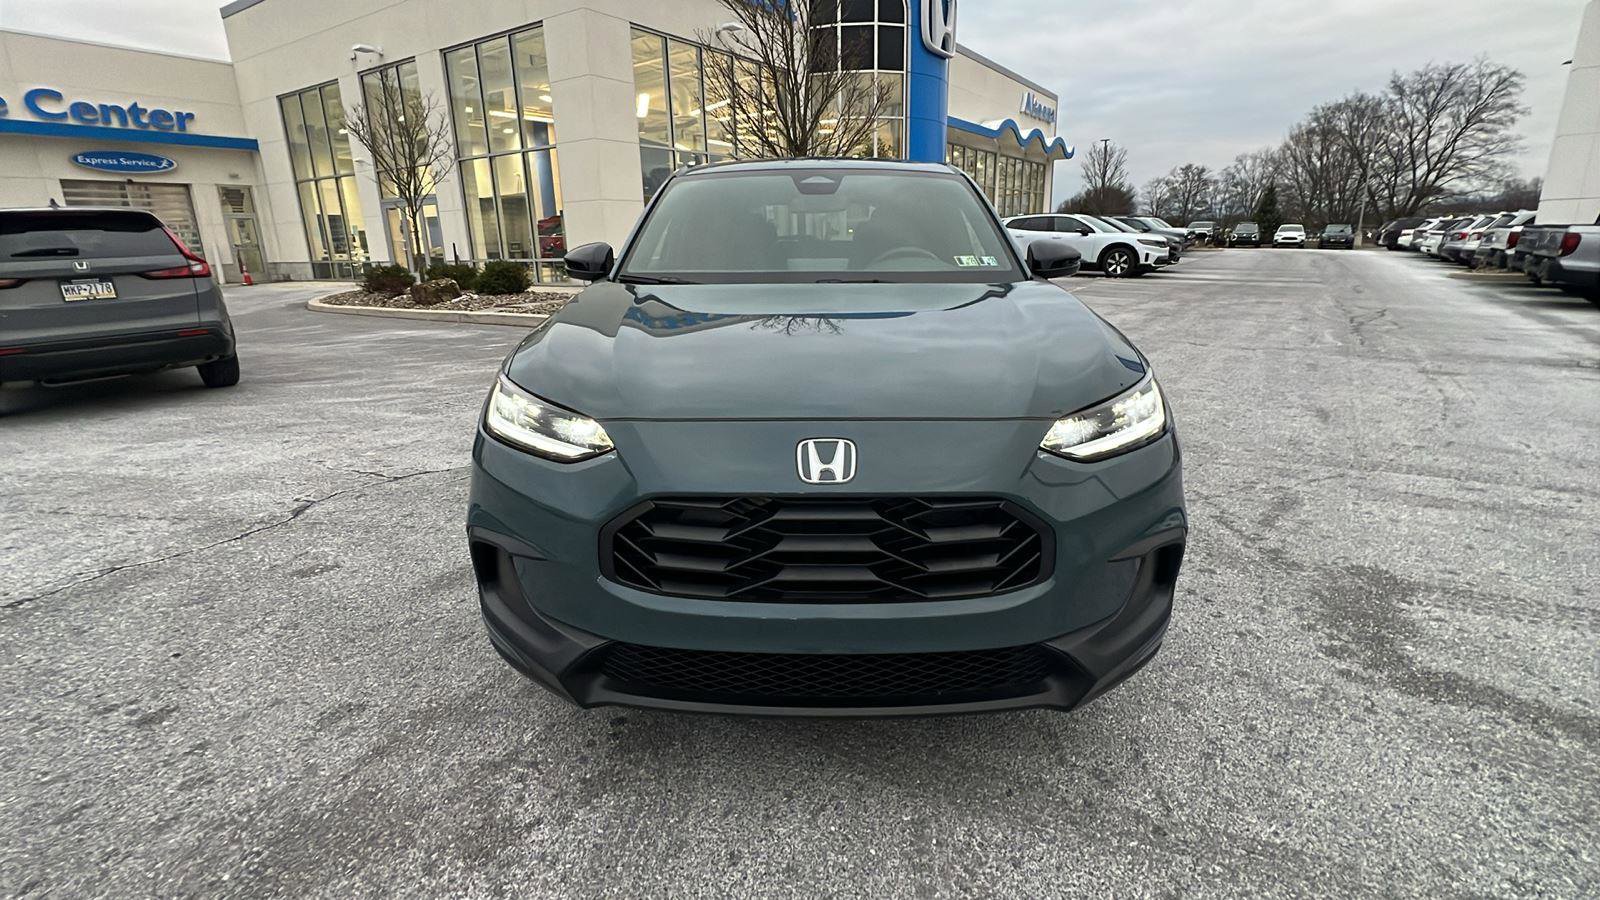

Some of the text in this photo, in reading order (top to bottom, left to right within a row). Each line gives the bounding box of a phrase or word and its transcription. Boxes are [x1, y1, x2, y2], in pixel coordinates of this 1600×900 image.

[24, 88, 195, 131] Center
[77, 155, 156, 167] Express Service
